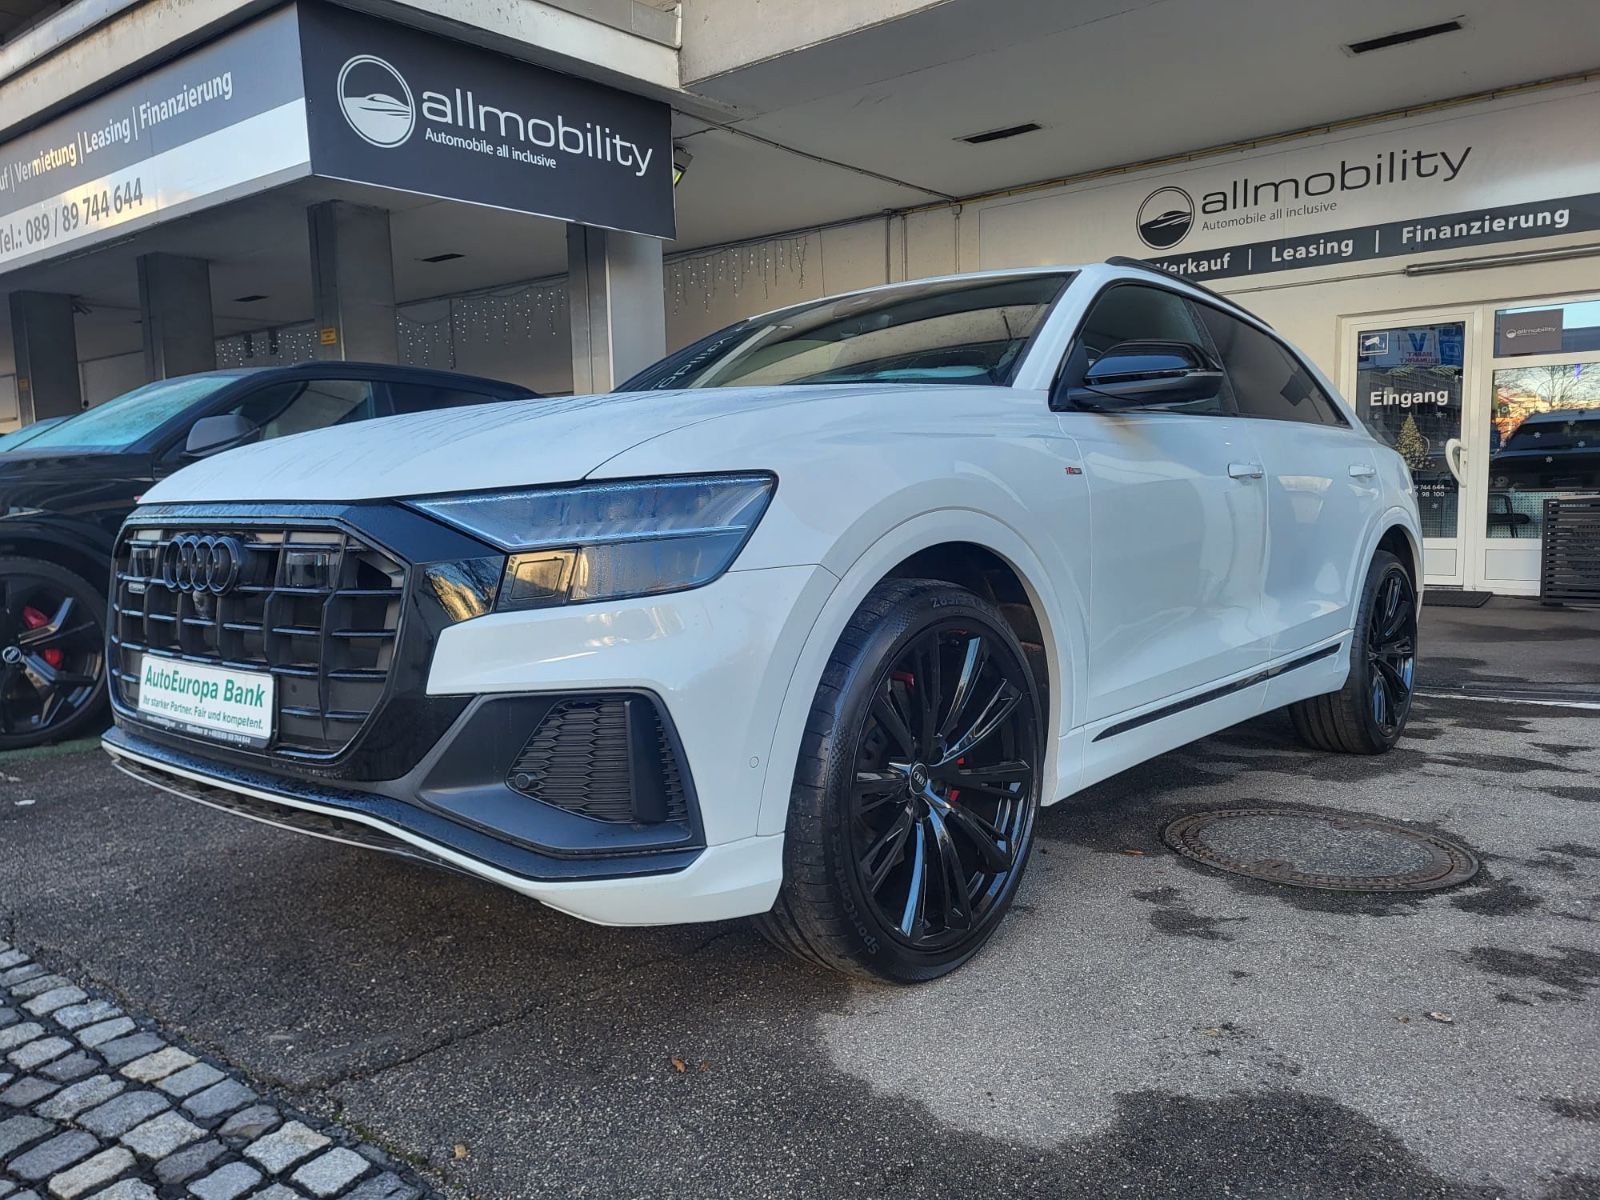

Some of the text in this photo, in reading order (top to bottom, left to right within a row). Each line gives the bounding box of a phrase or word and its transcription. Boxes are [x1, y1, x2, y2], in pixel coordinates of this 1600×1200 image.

[15, 142, 77, 183] Vermietung
[84, 116, 131, 154] Leasing
[139, 71, 233, 130] Finanzierung
[421, 88, 653, 177] allmobility
[425, 128, 557, 169] Automobile all inclusive
[1201, 146, 1473, 215] allmobility
[26, 212, 50, 246] 089
[62, 203, 79, 233] 89
[82, 190, 110, 226] 744
[113, 177, 144, 214] 644
[1201, 201, 1338, 232] Automobile all inclusive
[1271, 239, 1354, 263] Leasing
[1401, 208, 1570, 245] Finanzierung
[1370, 390, 1449, 408] Eingang
[144, 665, 266, 708] AutoEuropa Bank
[151, 697, 170, 711] starker
[170, 701, 193, 716] Partner.
[194, 706, 207, 718] Fair
[207, 711, 221, 722] und
[222, 712, 264, 730] kompetent.
